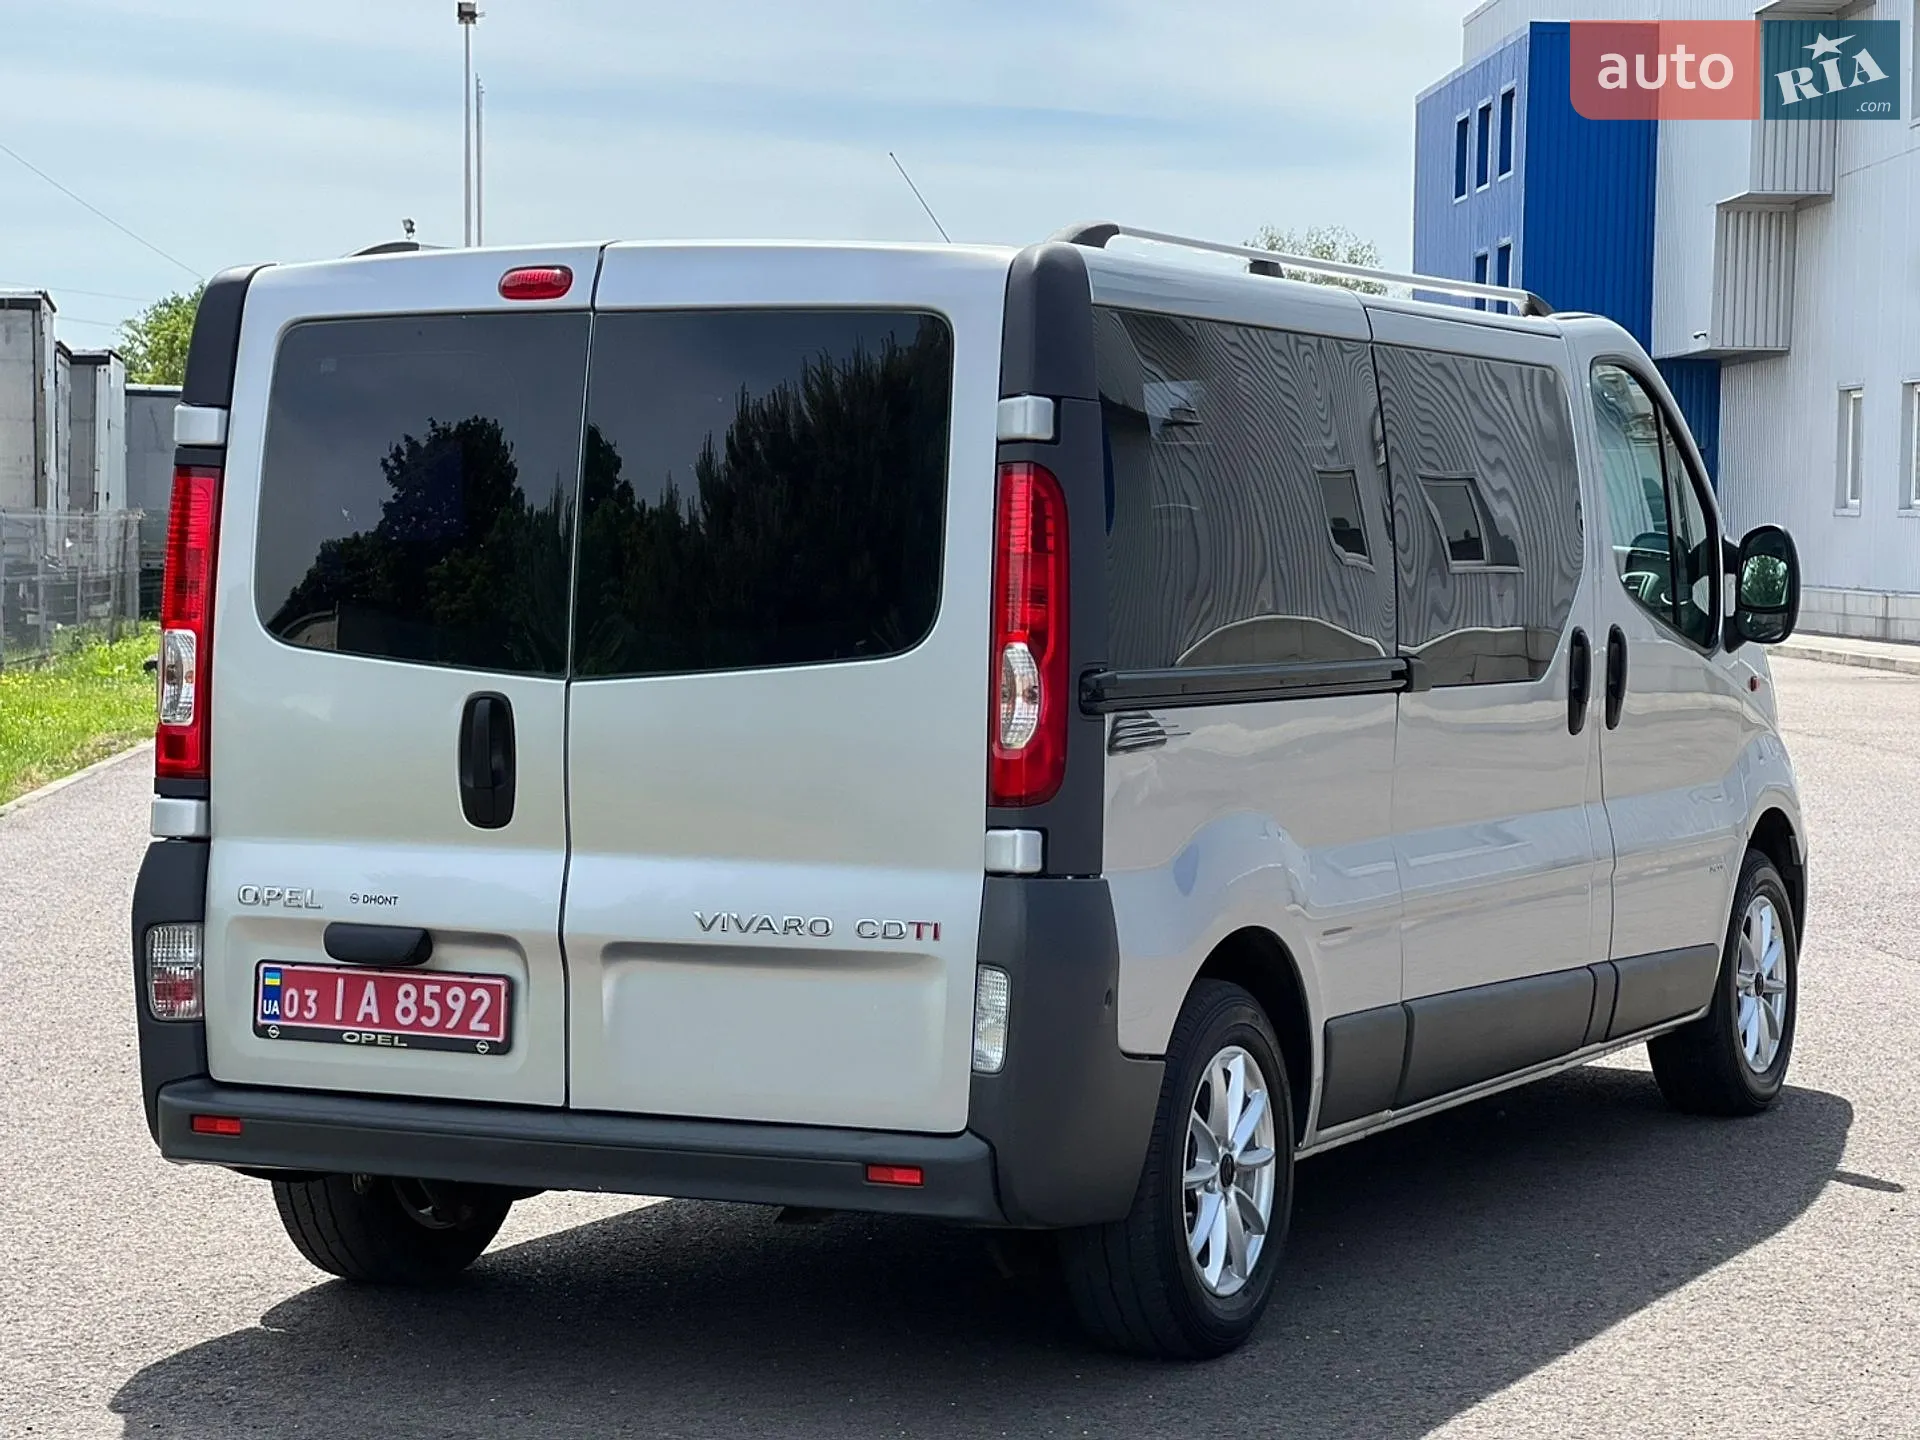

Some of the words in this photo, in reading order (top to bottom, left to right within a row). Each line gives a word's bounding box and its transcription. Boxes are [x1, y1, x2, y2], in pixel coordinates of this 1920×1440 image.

[238, 884, 323, 909] OPEL
[362, 894, 399, 906] DHONT
[693, 911, 834, 937] VIVARO
[855, 918, 941, 941] CDTI
[262, 999, 280, 1015] UA
[284, 987, 318, 1020] 03
[394, 983, 490, 1032] 8592
[342, 1031, 408, 1047] OPEL
